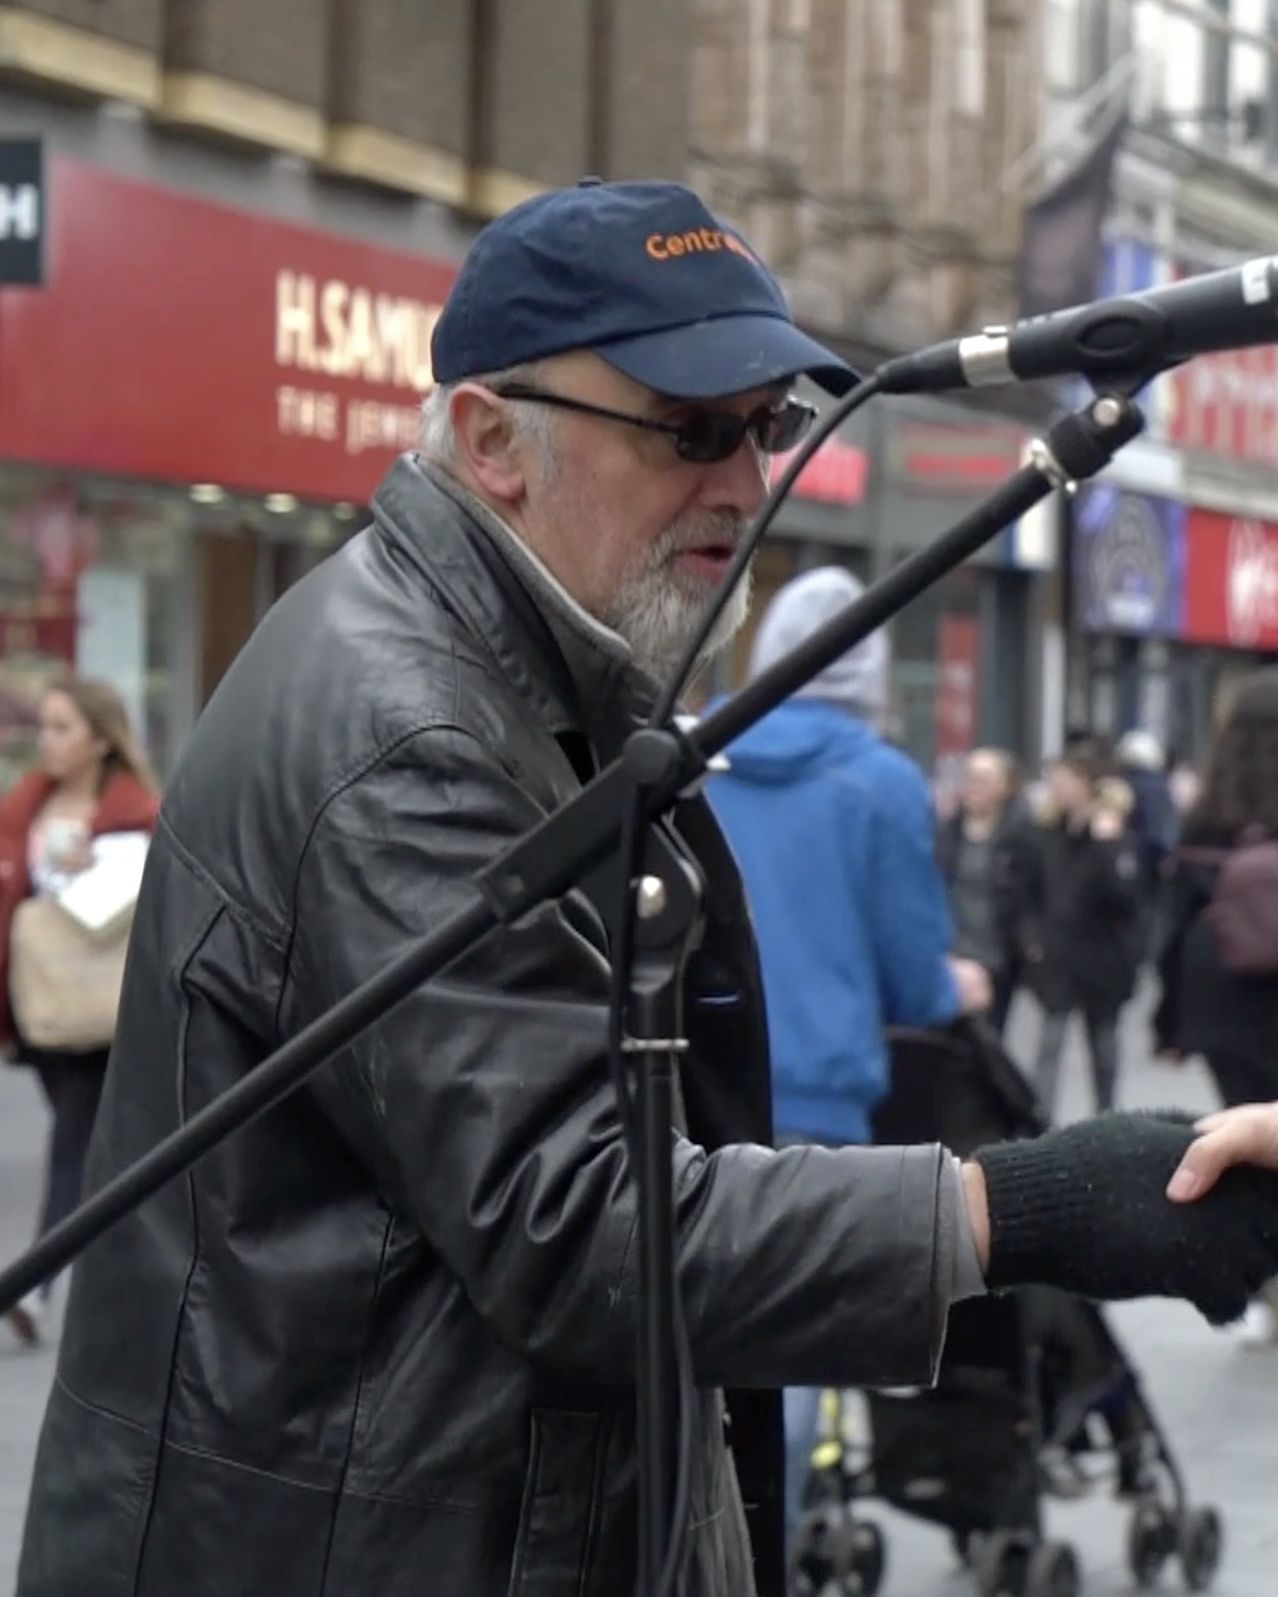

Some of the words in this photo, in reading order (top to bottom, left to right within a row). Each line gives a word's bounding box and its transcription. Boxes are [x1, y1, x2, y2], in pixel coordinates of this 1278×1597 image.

[275, 266, 443, 392] H.SAMU
[275, 385, 338, 441] THE
[346, 398, 422, 455] JEWE
